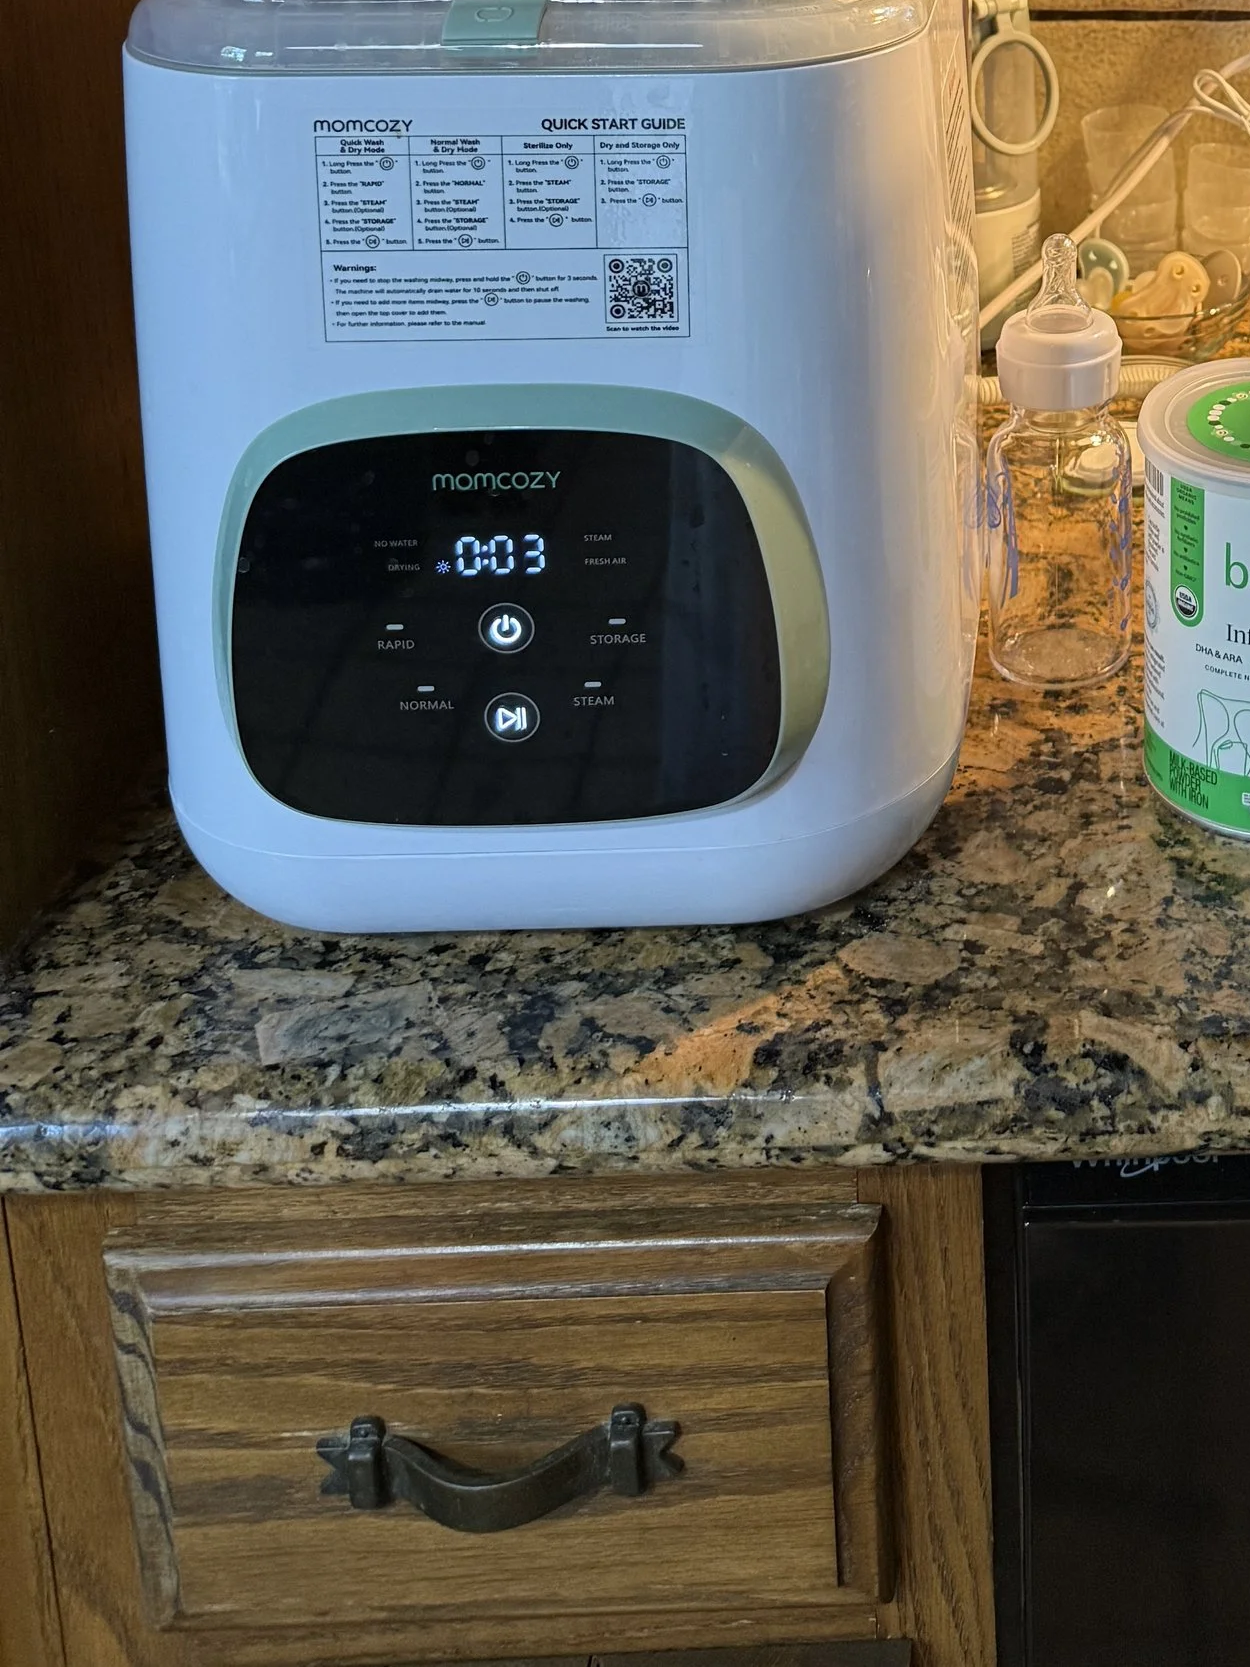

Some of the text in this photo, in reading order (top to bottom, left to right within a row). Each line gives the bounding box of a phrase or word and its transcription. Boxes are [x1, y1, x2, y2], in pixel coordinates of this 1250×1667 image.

[541, 118, 685, 132] QUICK START GUIDE
[348, 147, 362, 155] Dry
[555, 142, 573, 150] Only
[600, 142, 614, 150] Dry
[631, 142, 660, 150] Storage
[662, 142, 680, 150] Only
[333, 264, 376, 273] Warnings:
[584, 533, 612, 542] STEAM
[374, 539, 418, 548] NO WATER
[584, 556, 627, 565] FRESH AIR
[388, 563, 421, 572] DRYING
[377, 639, 415, 650] RAPID
[589, 633, 646, 645] STORAGE
[1195, 643, 1243, 664] DHA & ARA
[1204, 664, 1242, 680] COMPLETE
[399, 700, 454, 711] NORMAL
[573, 695, 615, 706] STEAM
[1170, 750, 1218, 785] MILK-BASED
[1189, 788, 1208, 809] IRON
